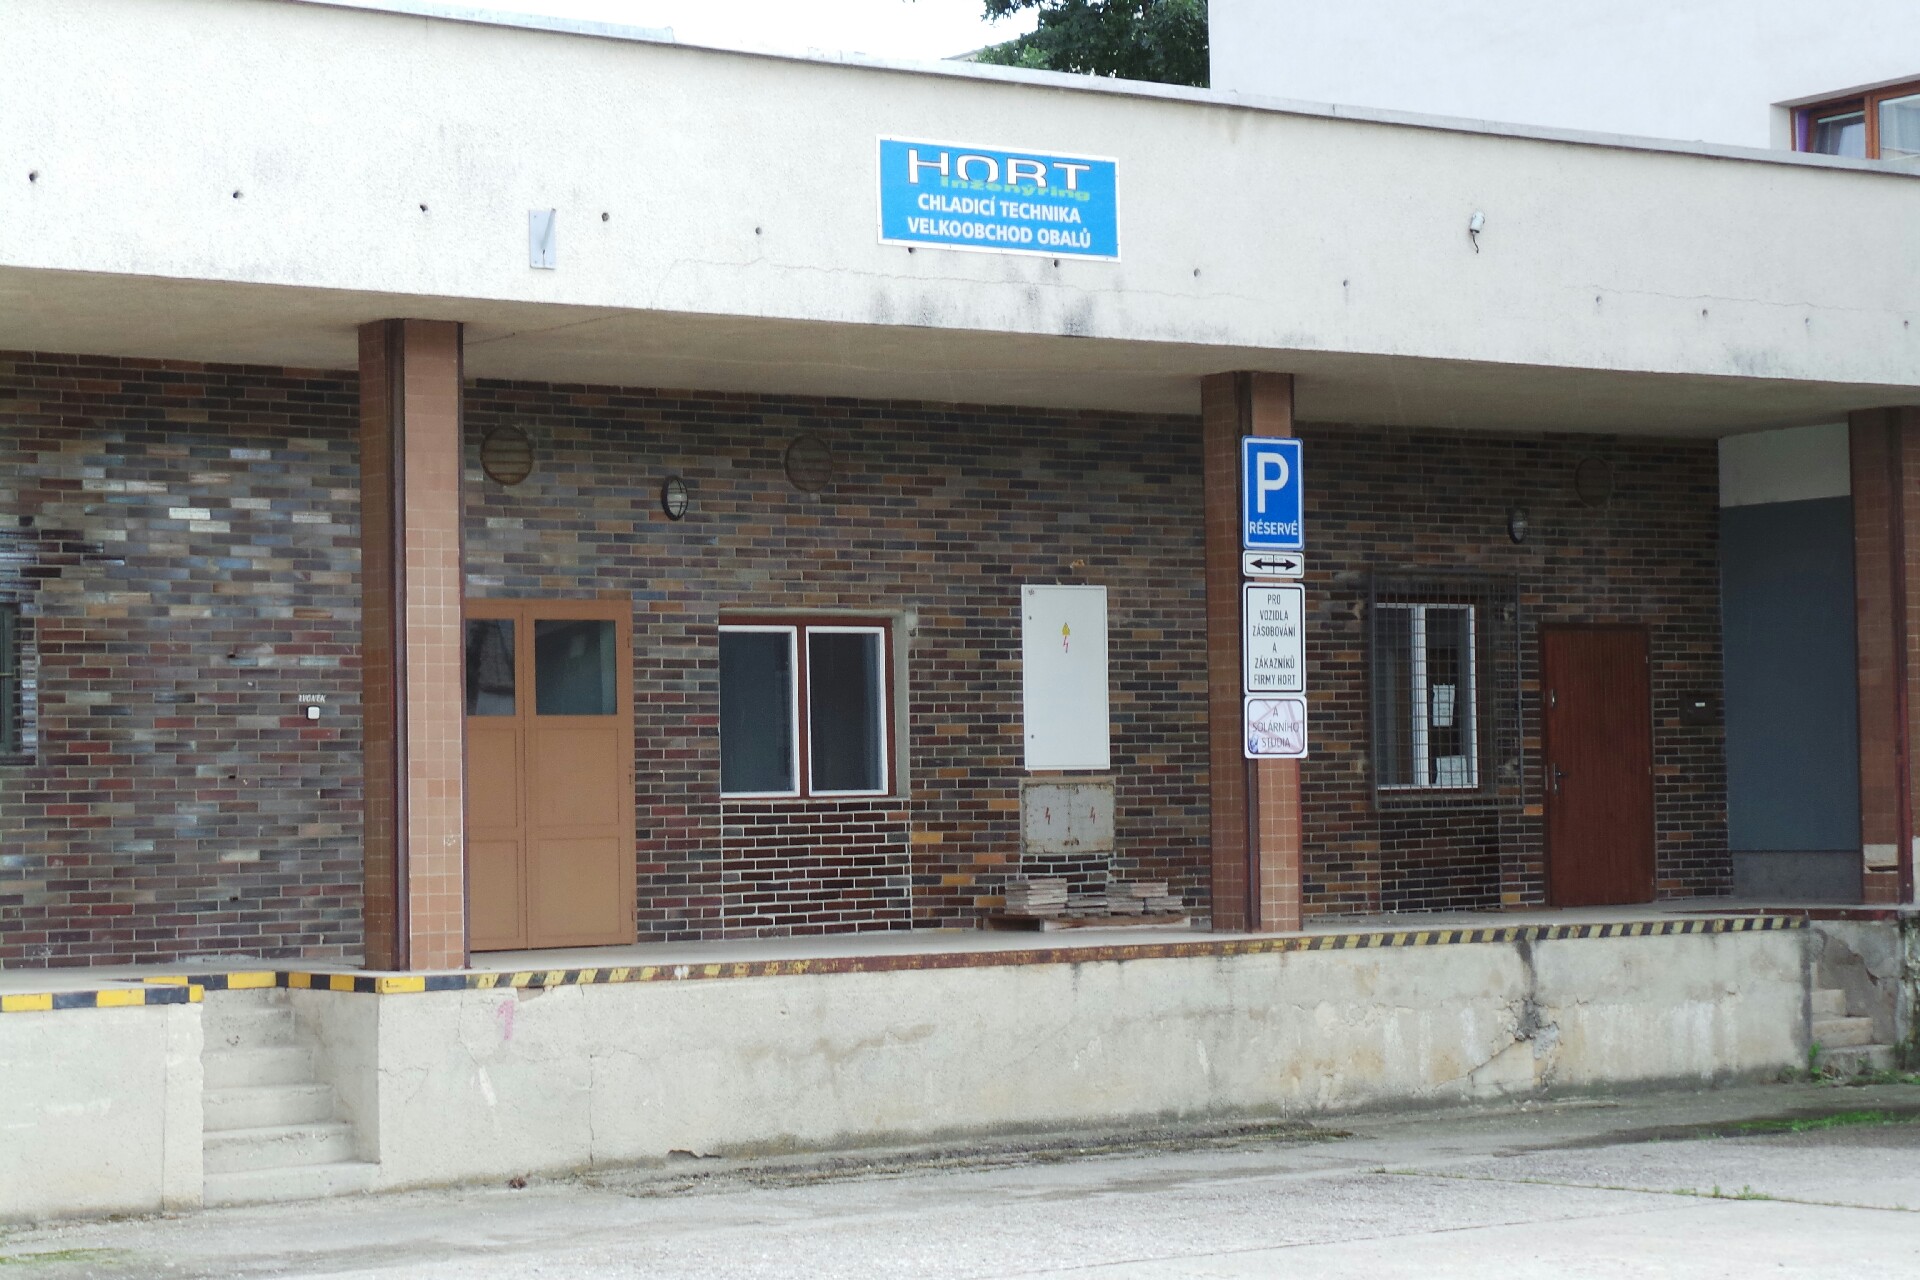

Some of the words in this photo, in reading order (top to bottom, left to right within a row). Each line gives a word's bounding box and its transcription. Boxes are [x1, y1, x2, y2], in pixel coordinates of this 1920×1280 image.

[908, 148, 1090, 190] HORT
[917, 194, 995, 217] CHLADICÍ
[1000, 200, 1081, 224] TECHNIKA
[908, 216, 1032, 243] VELKOOBCHOD
[1037, 227, 1091, 248] OBALŮ
[1256, 452, 1289, 514] P
[1249, 518, 1298, 536] RÉSERVÉ
[1267, 594, 1281, 606] PRO
[1259, 609, 1289, 621] VOZIDLA
[1252, 623, 1296, 637] ZÁSOBOVÁNÍ
[1272, 642, 1277, 653] A
[1254, 655, 1295, 669] ZÁKAZNÍKŮ
[1253, 674, 1276, 686] FIRMY
[1277, 674, 1296, 686] HORT
[1272, 705, 1279, 717] A
[1252, 719, 1299, 733] SOLÁRNÍHO
[1261, 737, 1291, 748] STUDIA
